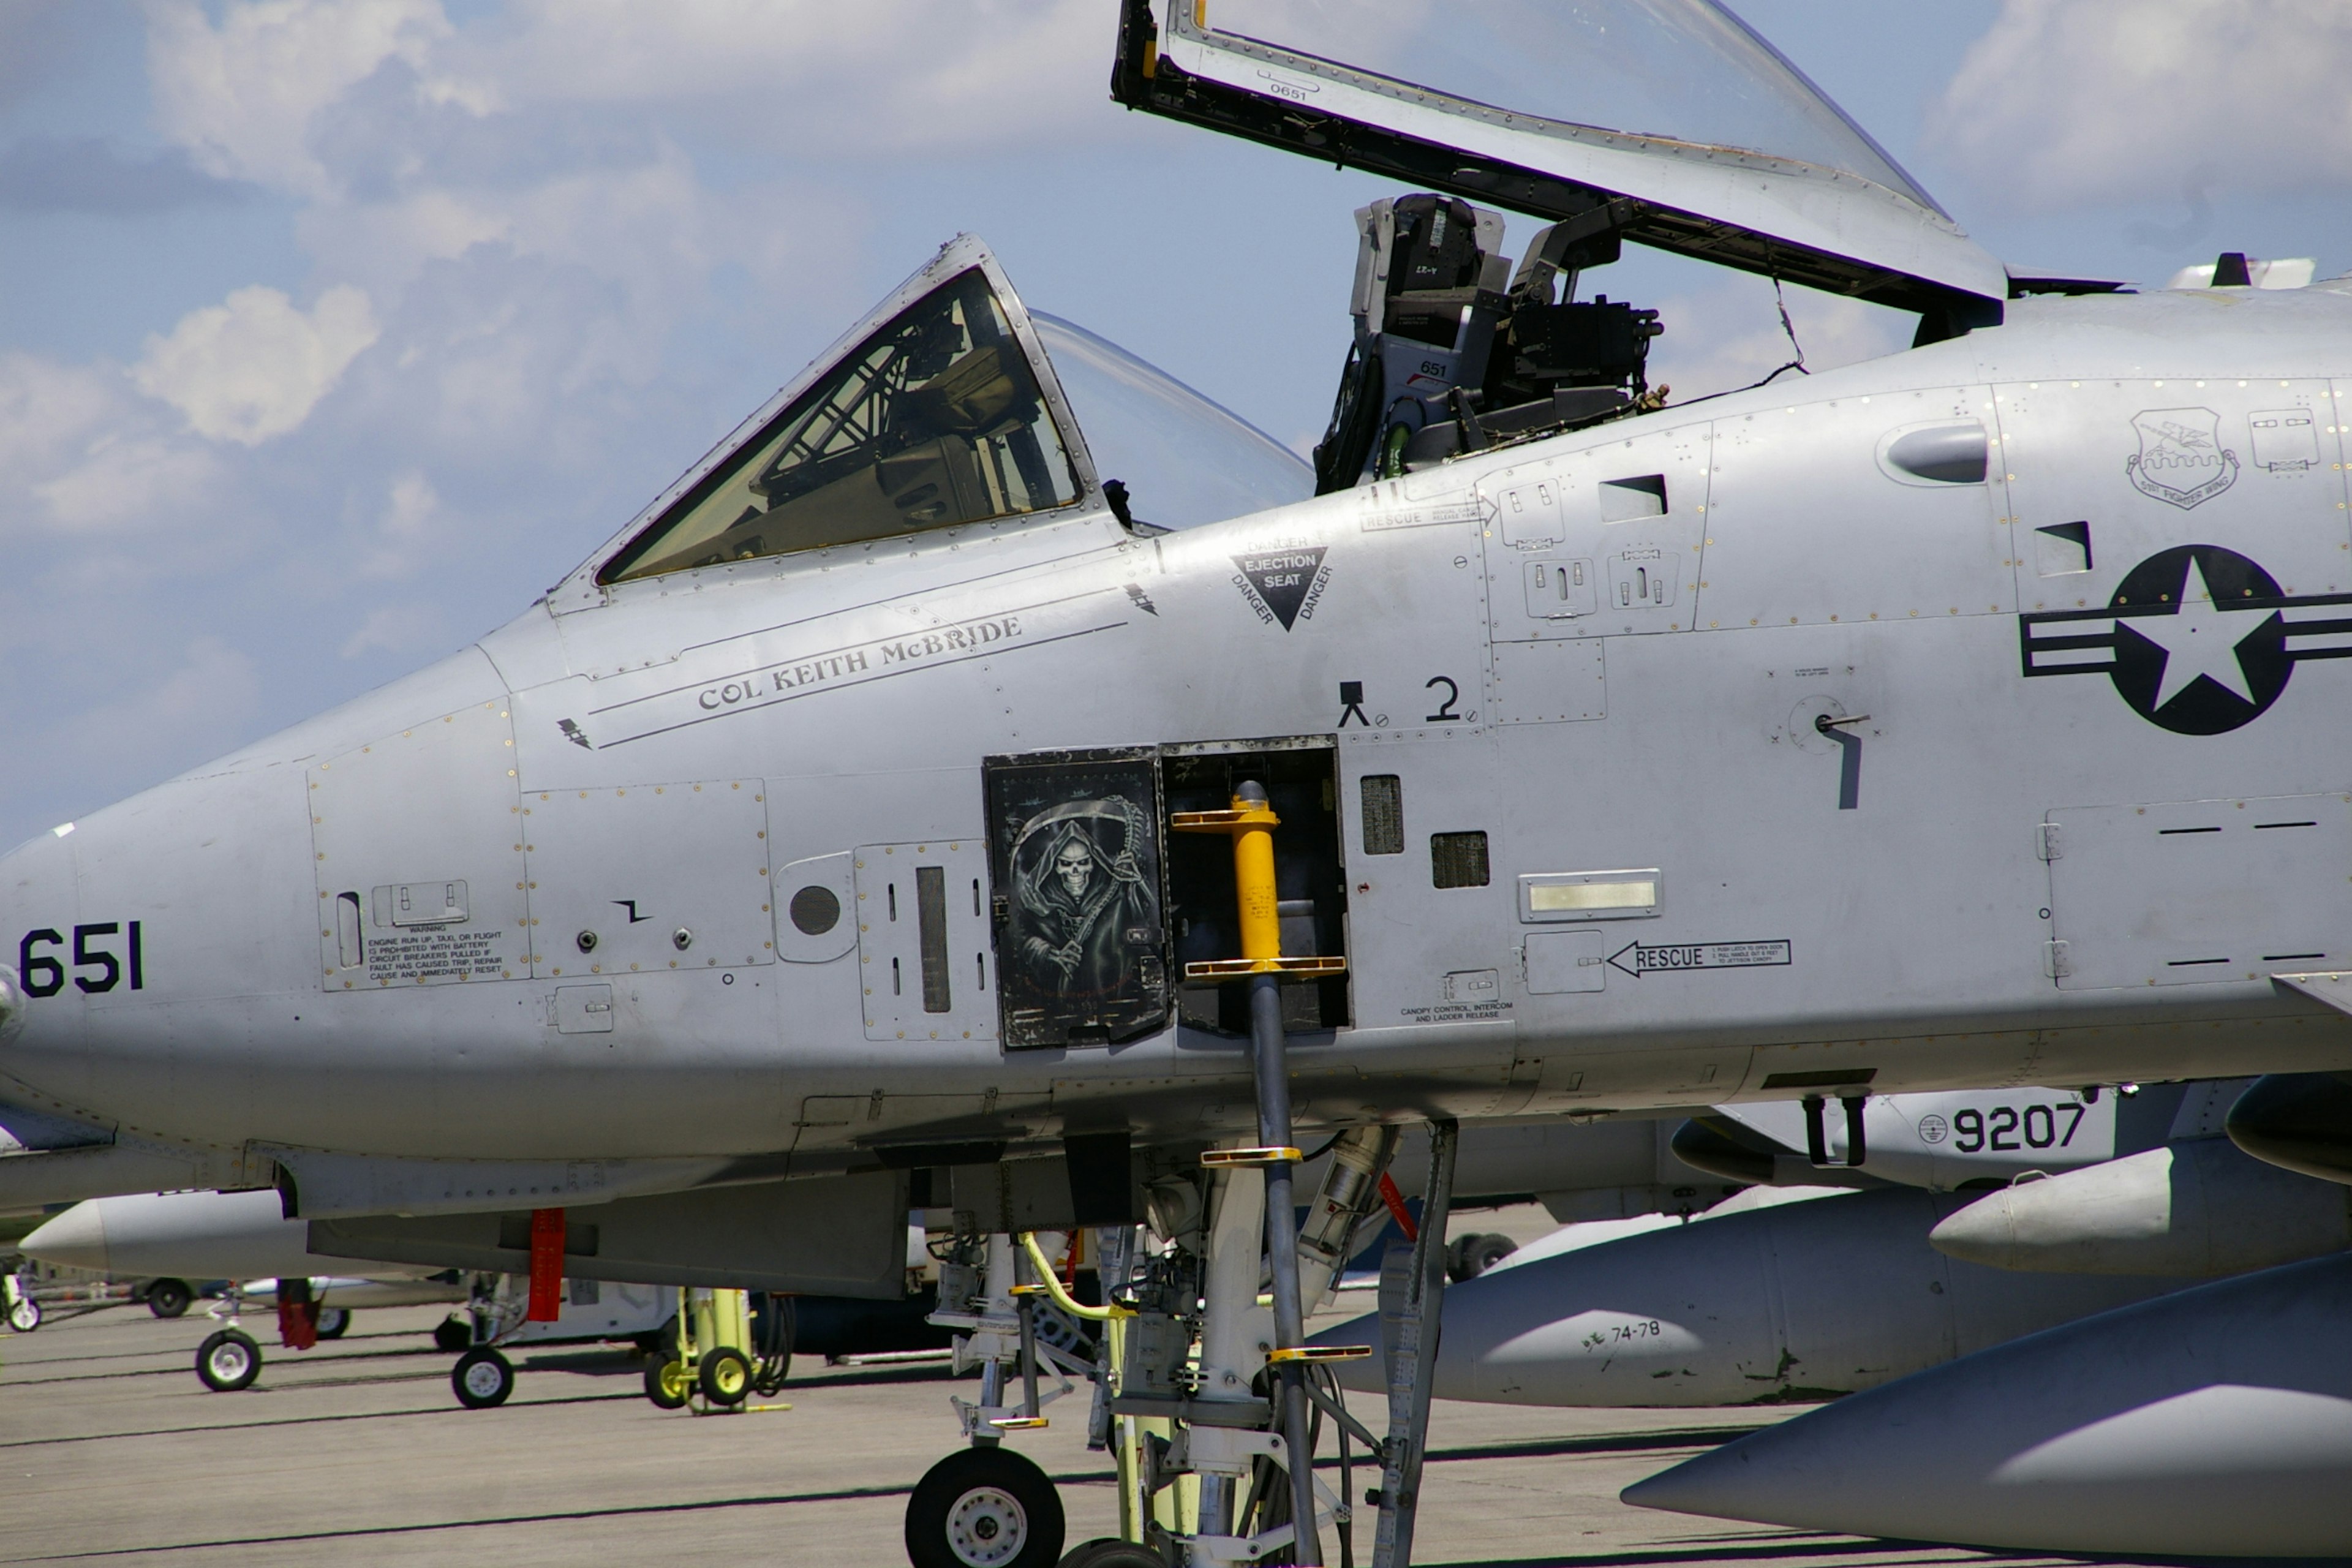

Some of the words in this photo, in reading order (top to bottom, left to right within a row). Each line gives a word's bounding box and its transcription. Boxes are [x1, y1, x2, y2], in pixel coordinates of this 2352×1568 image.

[1271, 84, 1306, 100] 0651
[1420, 361, 1447, 377] 651
[2164, 490, 2204, 505] FIGHTER
[2205, 476, 2229, 495] WING
[1367, 512, 1422, 527] RESCUE
[1248, 536, 1308, 551] DANGER
[1245, 554, 1317, 572] EJECTION
[1264, 574, 1301, 588] SEAT
[1231, 574, 1274, 625] DANGER
[1300, 565, 1333, 620] DANGER
[698, 680, 763, 710] COL
[772, 650, 869, 692] KEITH
[881, 616, 1023, 665] McBRIDE
[474, 931, 502, 940] FLIGHT
[380, 945, 428, 954] PROHIBITED
[453, 941, 489, 949] BATTERY
[20, 921, 143, 998] 651
[404, 952, 447, 961] BREAKERS
[1637, 949, 1703, 968] RESCUE
[421, 967, 472, 977] IMMEDIATELY
[1474, 1002, 1513, 1011] INTERCOM
[1434, 1013, 1463, 1022] LADDER
[1954, 1102, 2086, 1153] 9207
[1611, 1321, 1660, 1342] 74-78
